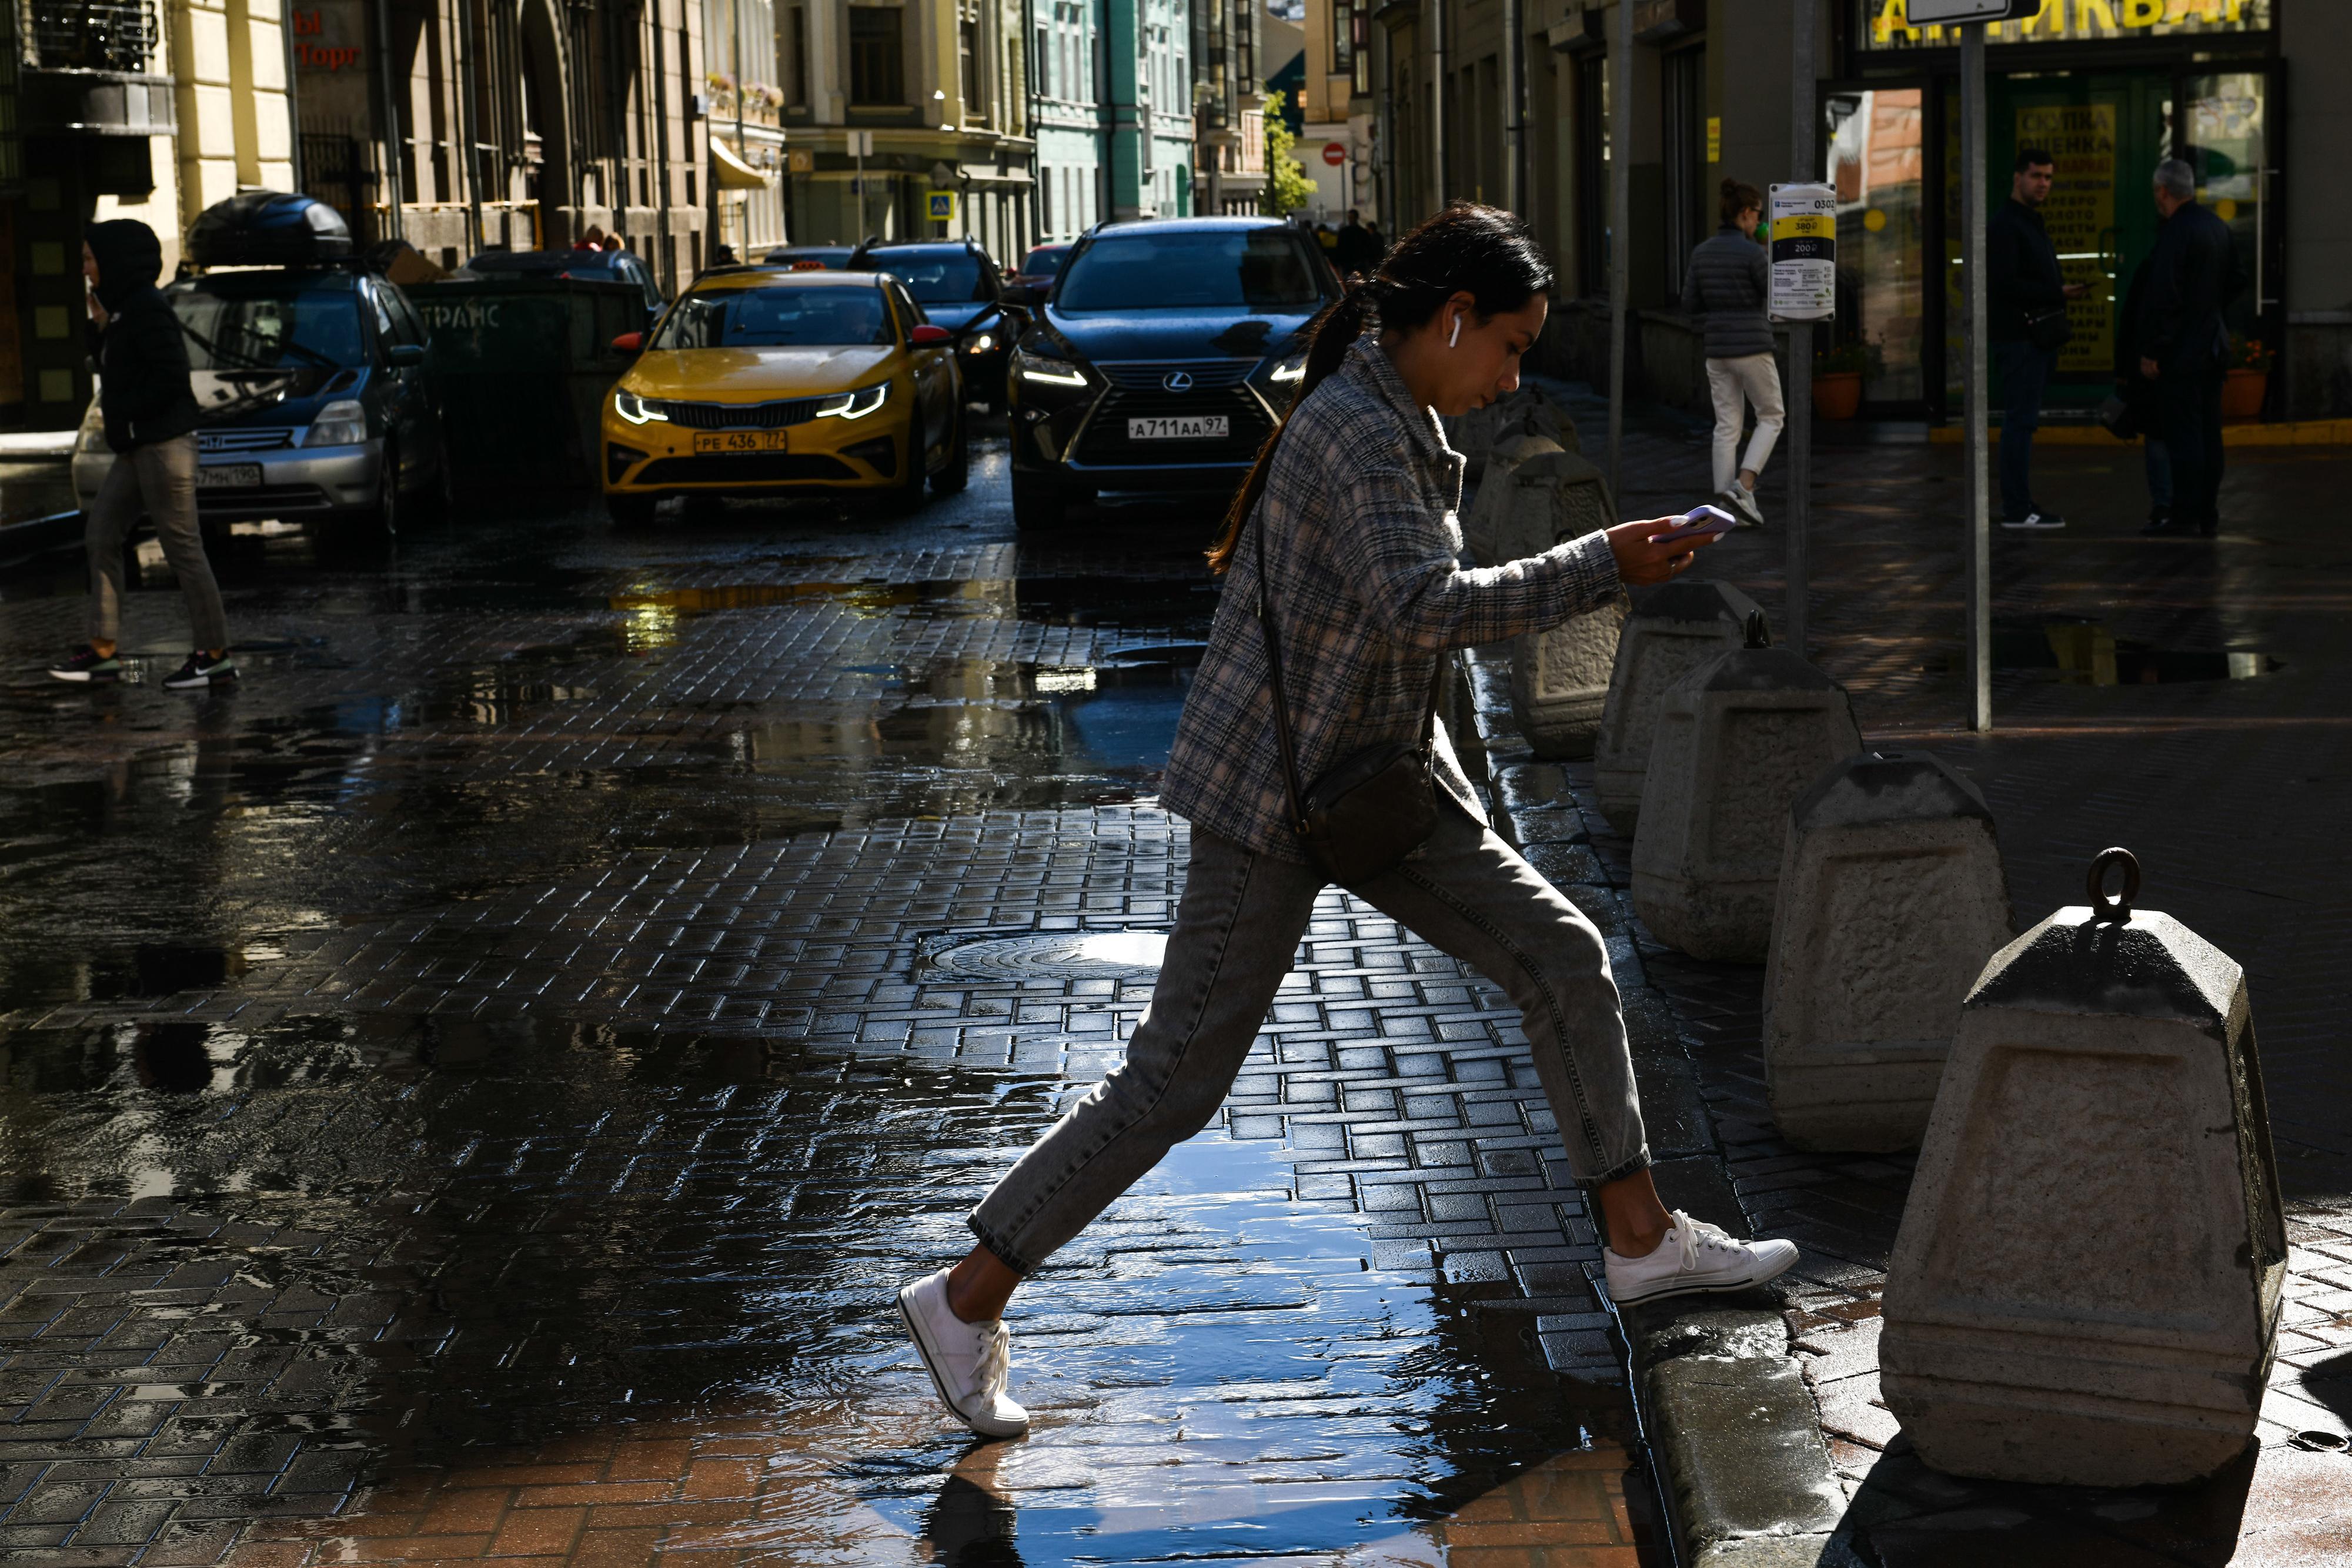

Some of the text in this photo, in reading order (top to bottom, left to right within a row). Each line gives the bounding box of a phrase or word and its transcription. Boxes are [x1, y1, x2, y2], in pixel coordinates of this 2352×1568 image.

[2023, 112, 2109, 132] СКУПКА
[2021, 136, 2111, 154] ОЦЕНКА
[1815, 200, 1835, 209] 0302
[2042, 196, 2096, 206] ЕРЕБРО
[2044, 210, 2094, 220] ОЛОТО
[1795, 222, 1810, 230] 380
[2047, 224, 2095, 234] ОНЕТЫ
